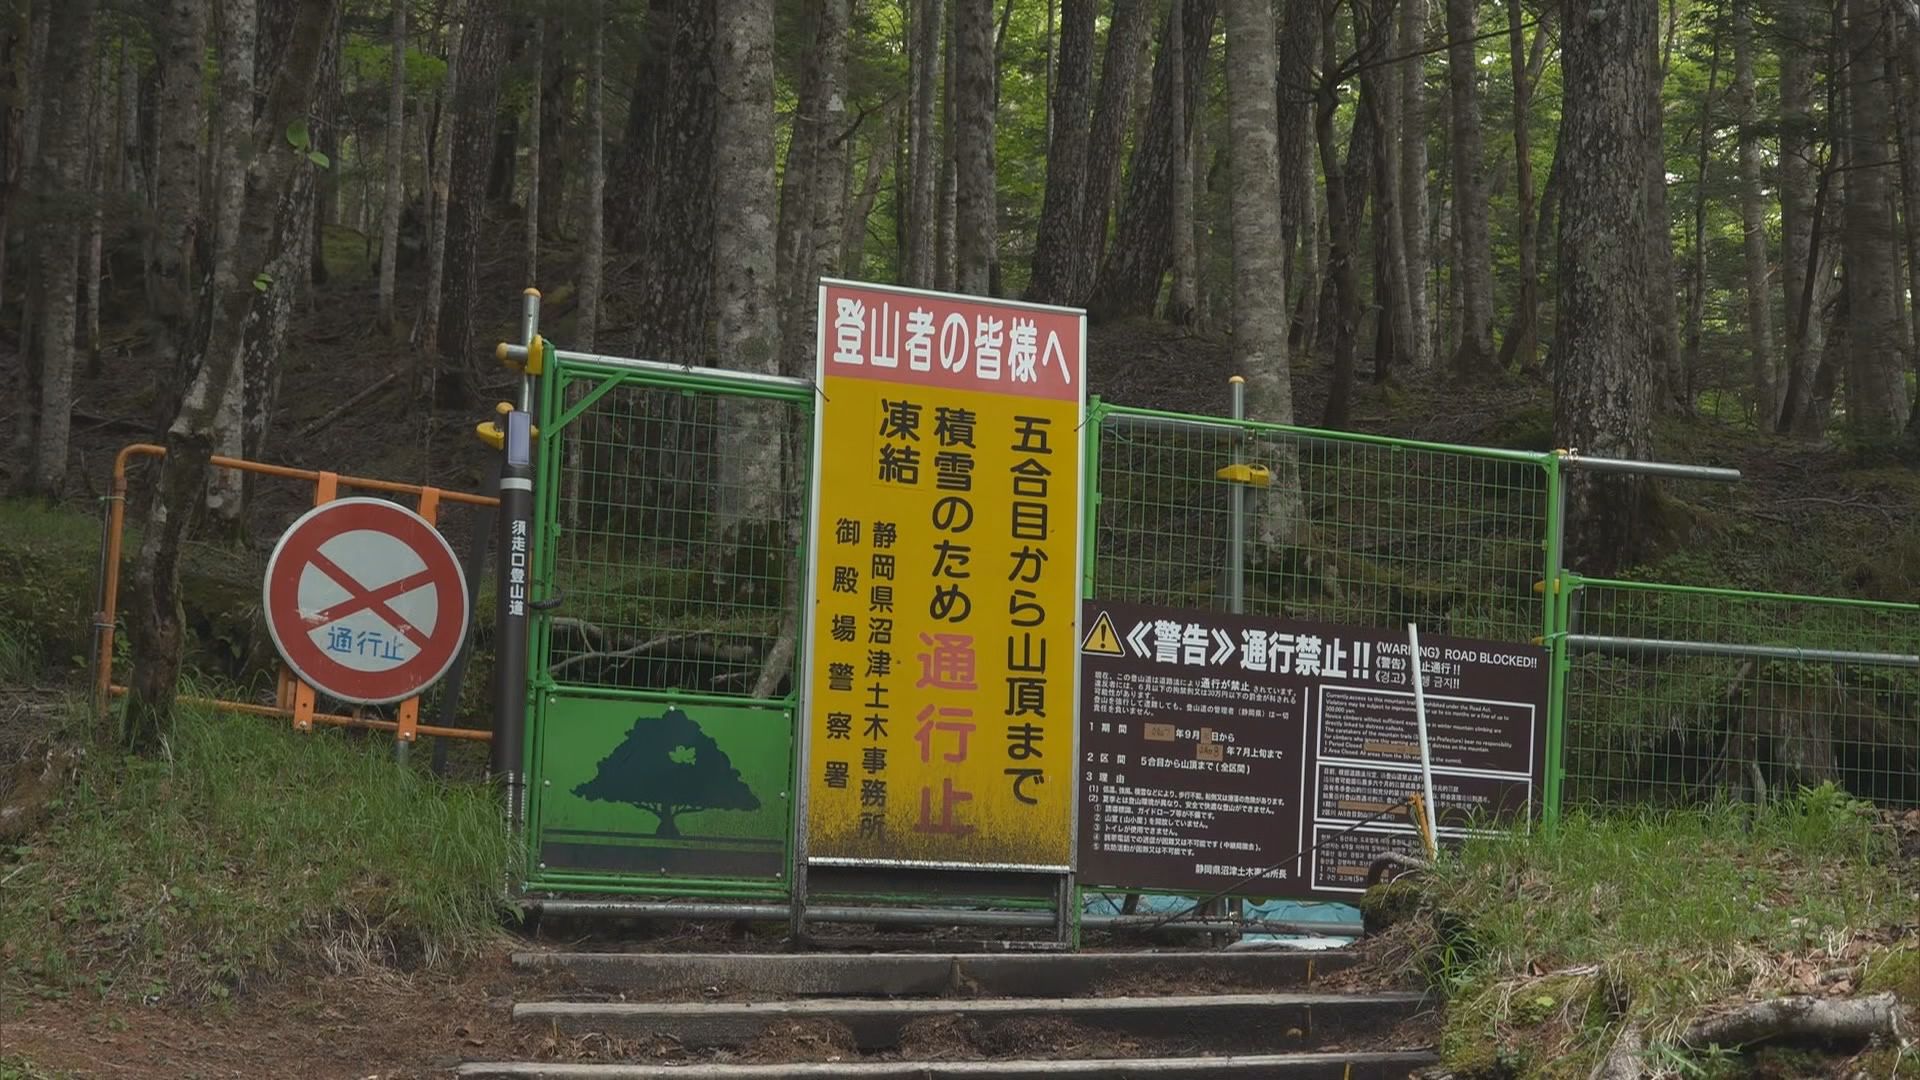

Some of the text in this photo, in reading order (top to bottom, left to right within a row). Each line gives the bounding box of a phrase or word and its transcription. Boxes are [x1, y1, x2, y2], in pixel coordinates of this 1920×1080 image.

[833, 298, 1071, 384] 登山者の皆様へ
[879, 398, 922, 485] 凍結
[508, 520, 526, 616] 須走口登山道
[1004, 415, 1052, 805] 五合目から山頂まで
[326, 626, 405, 661] 通行止
[824, 517, 860, 790] 御殿場警察署
[860, 521, 897, 840] 静岡県沼津土木事務所
[1376, 641, 1537, 669] 《WARNG》 ROAD BLOCKED!!
[1087, 752, 1094, 762] 2
[1089, 722, 1094, 731] 1
[1086, 771, 1093, 781] 3
